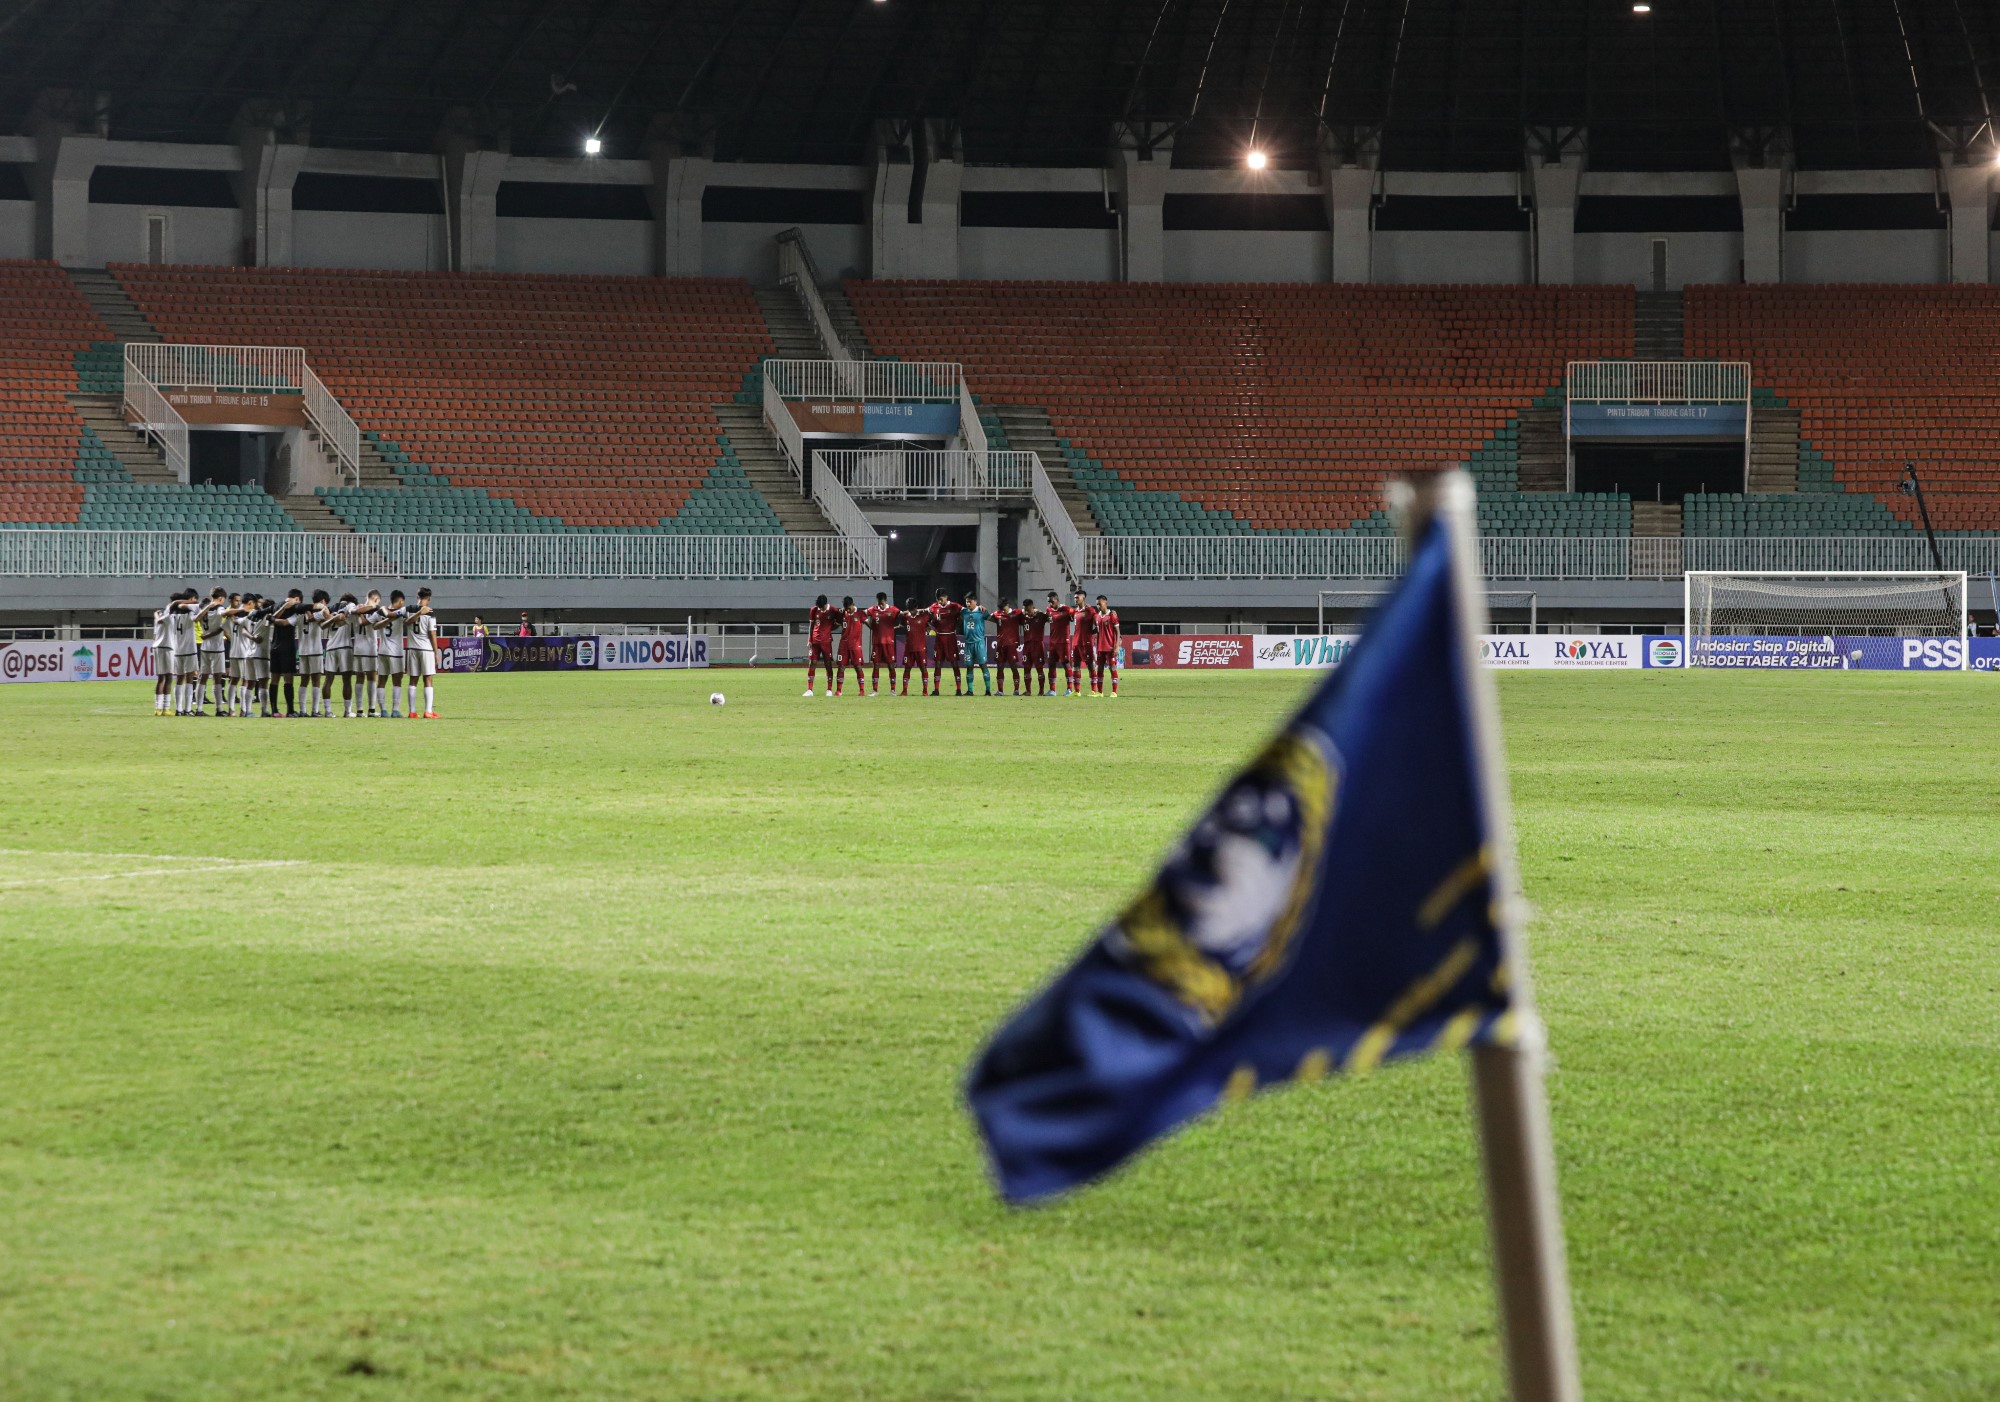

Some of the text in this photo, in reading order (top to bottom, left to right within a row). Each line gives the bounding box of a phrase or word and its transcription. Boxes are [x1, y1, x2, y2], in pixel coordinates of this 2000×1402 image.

[169, 395, 269, 407] PINTU TRIBUN TRIBUNE GATE 15
[811, 405, 913, 416] PINTU TRIBUN TRIBUNE GATE 16
[1607, 407, 1707, 418] PINTU TRIBUN TRIBUNE GATE 17
[1194, 640, 1244, 649] OFFICIAL
[1294, 635, 1352, 665] Whit
[1554, 640, 1628, 660] ROYAL
[1695, 640, 1832, 656] Indosiar Siap Digital
[504, 646, 564, 661] ACADEMY
[564, 643, 576, 664] 5
[619, 640, 707, 664] INDOSIAR
[1193, 648, 1240, 657] GARUDA
[3, 646, 64, 679] @pssi
[96, 644, 122, 678] Le
[1191, 656, 1230, 665] STORE
[1690, 655, 1840, 667] JABODETABEK 24 UHF
